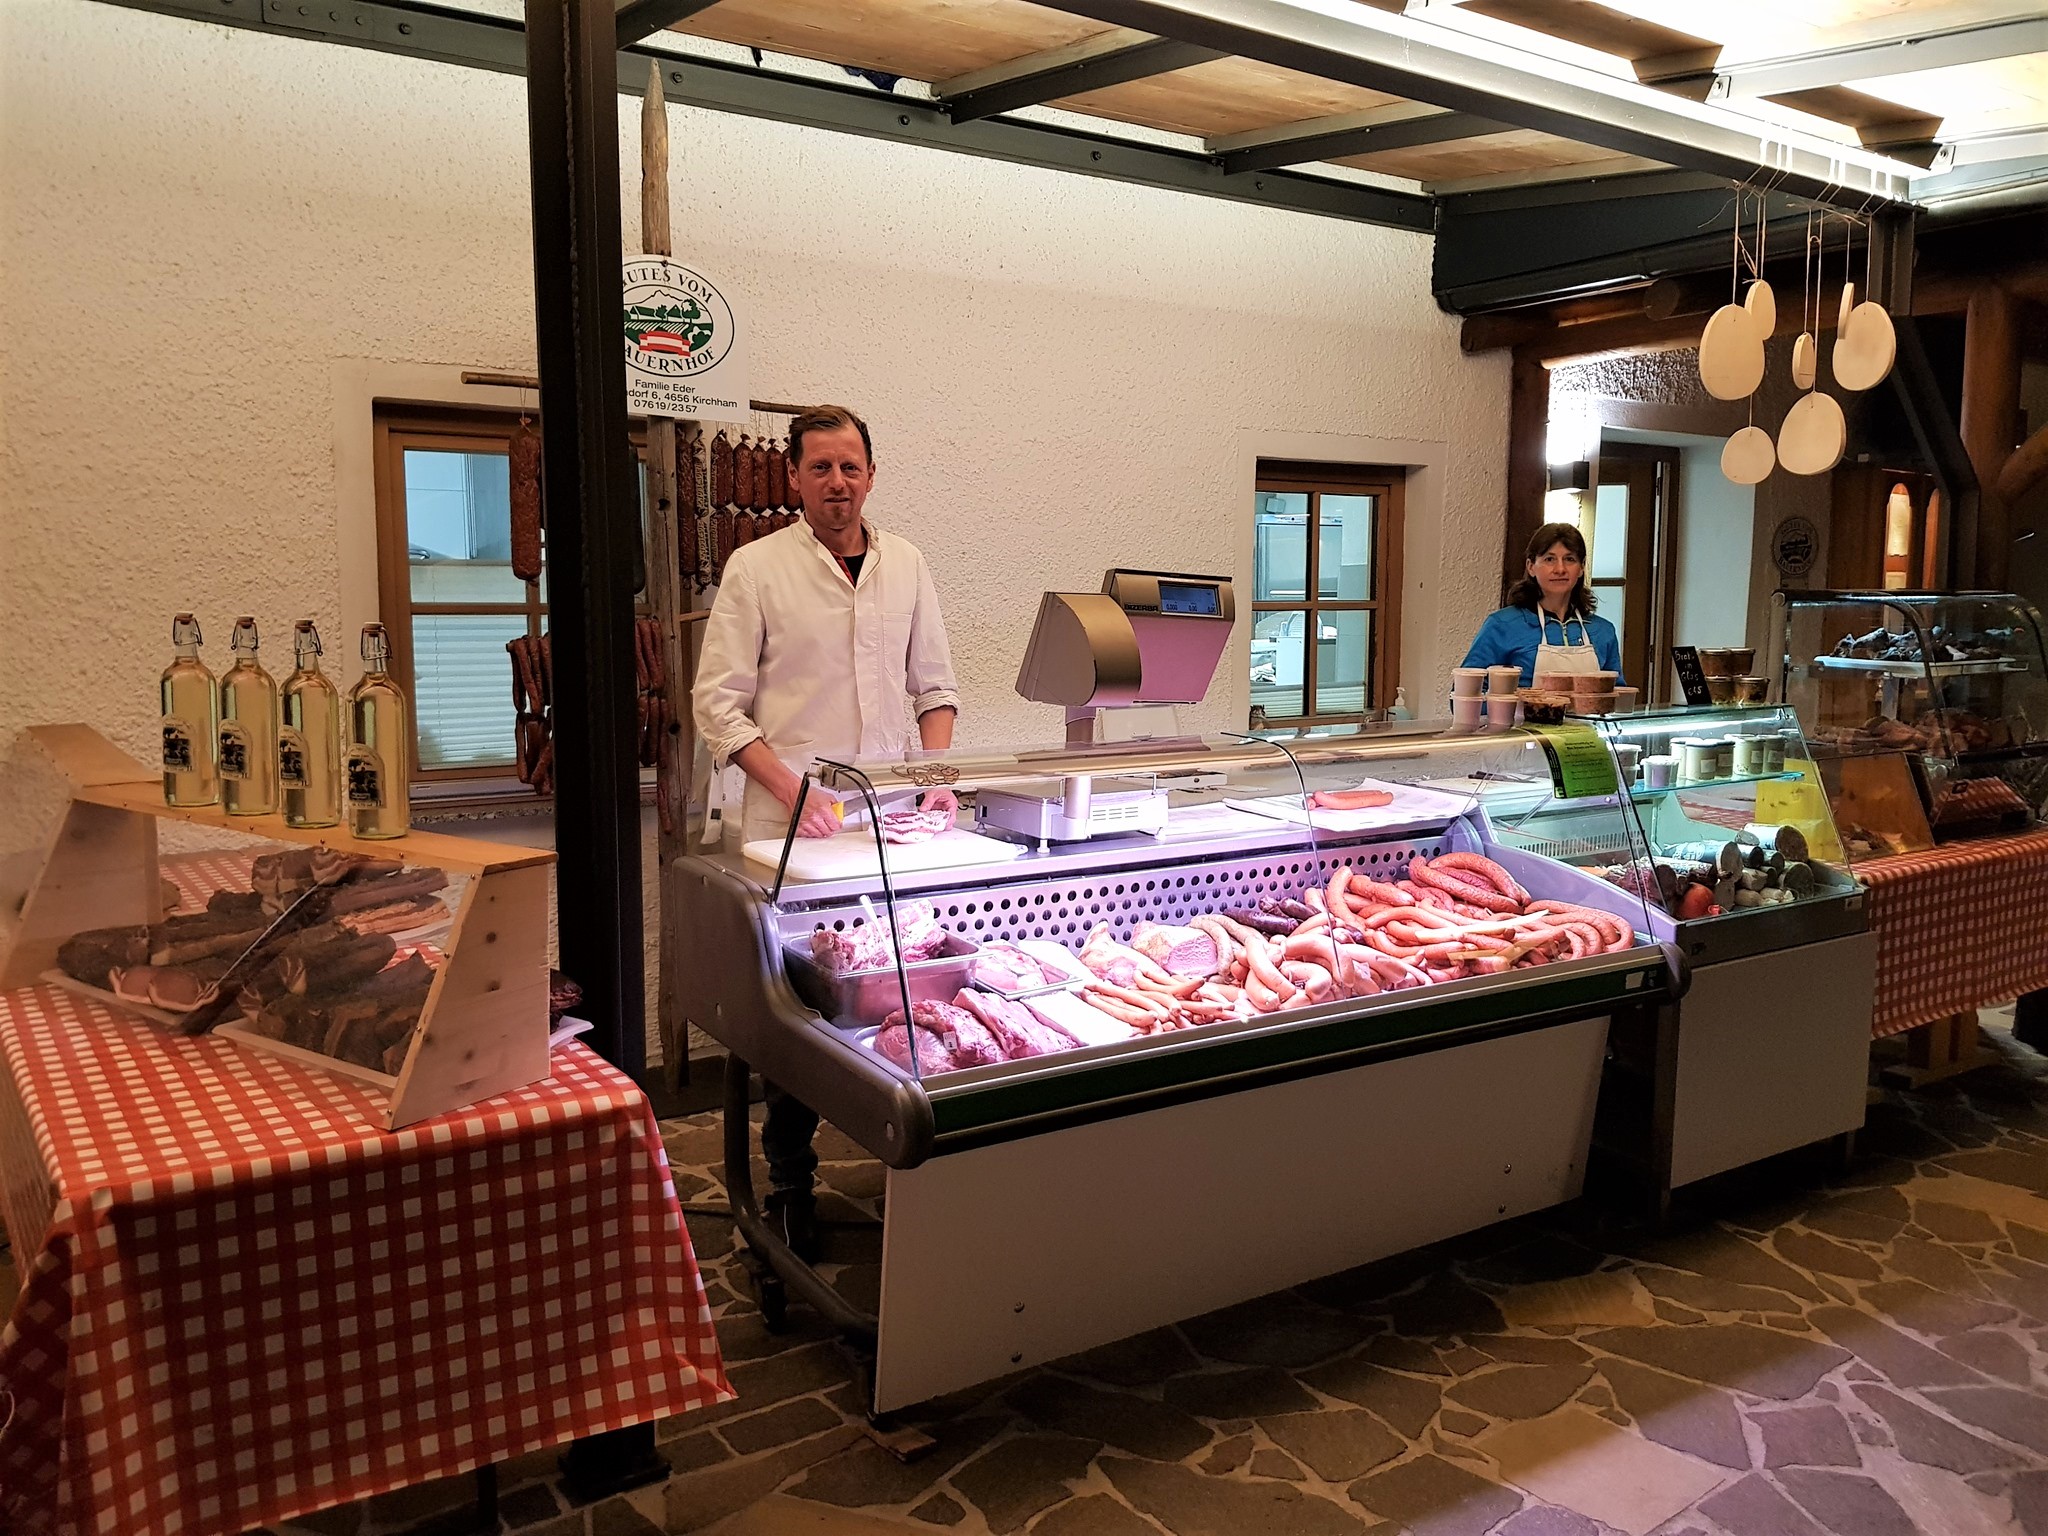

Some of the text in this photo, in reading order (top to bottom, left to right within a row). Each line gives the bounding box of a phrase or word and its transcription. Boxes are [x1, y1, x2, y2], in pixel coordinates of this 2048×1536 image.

[623, 267, 713, 303] UTES VOM
[624, 343, 715, 373] AUERNHOF
[635, 379, 696, 393] Familie Eder
[633, 400, 698, 413] 07619/2357
[651, 391, 661, 400] 6,
[664, 393, 690, 403] 4656
[692, 395, 738, 408] Kirchham
[1124, 603, 1159, 612] BIZERBA
